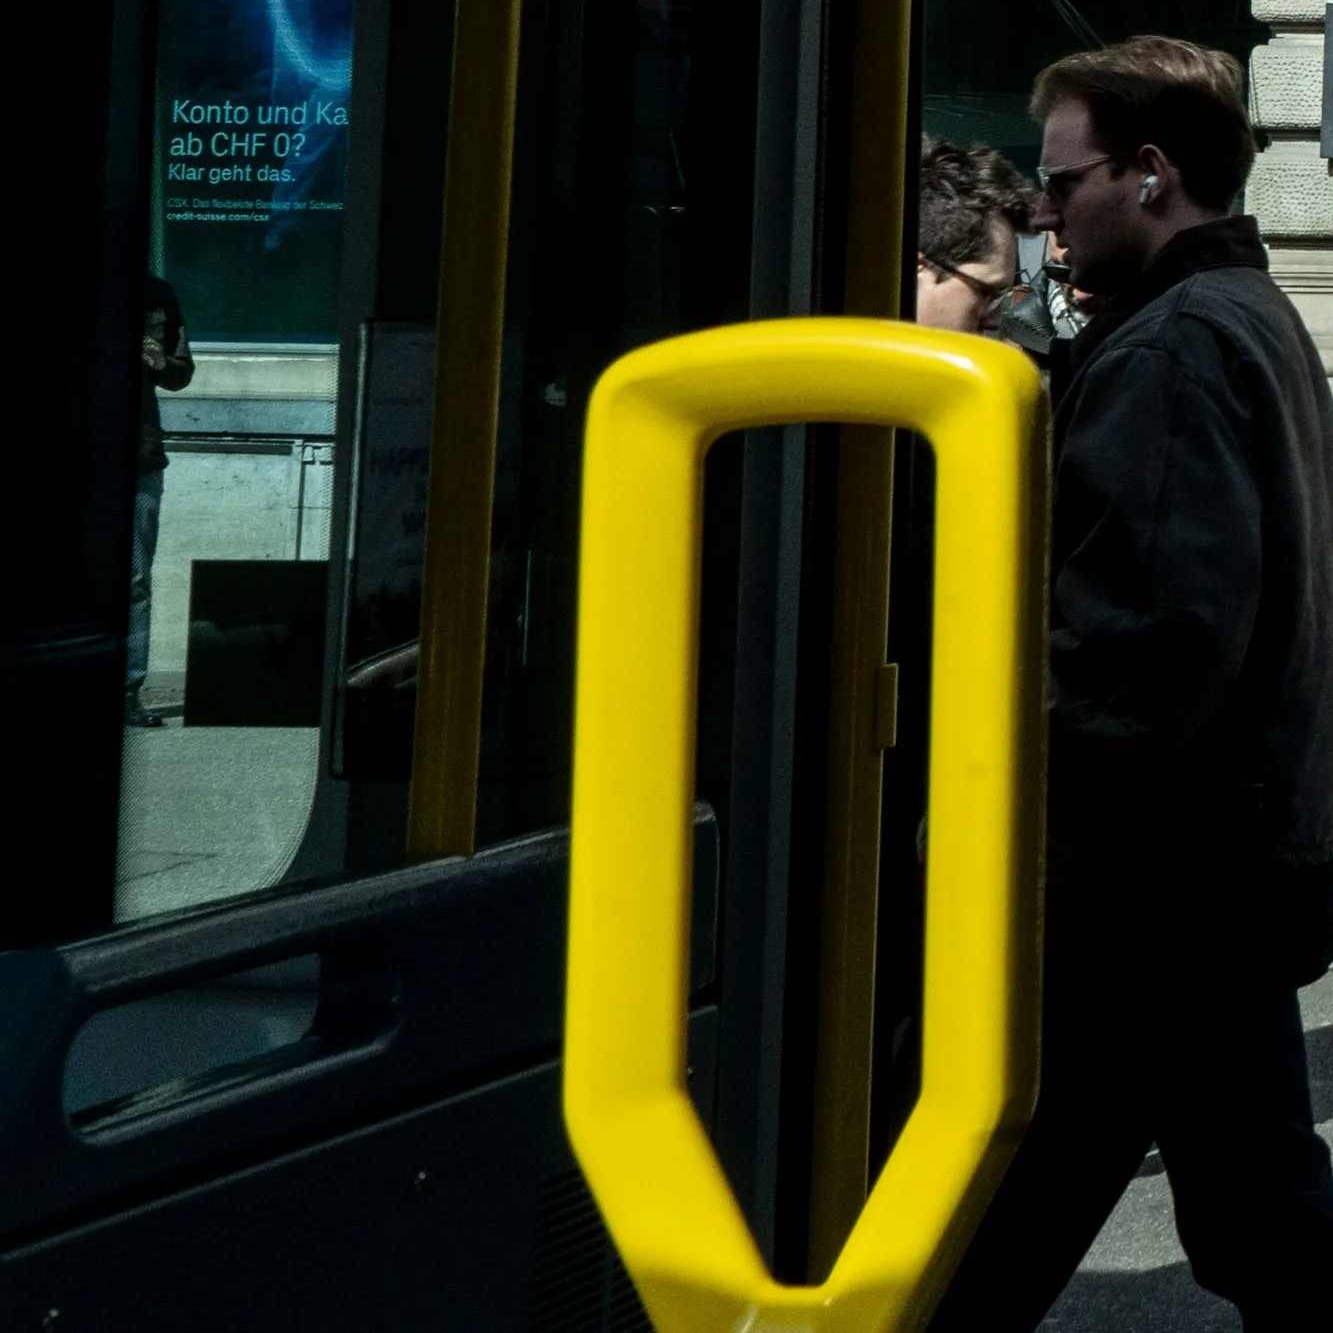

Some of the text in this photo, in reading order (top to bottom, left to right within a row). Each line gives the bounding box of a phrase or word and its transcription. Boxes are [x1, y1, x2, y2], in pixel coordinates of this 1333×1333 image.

[171, 99, 349, 126] Konto und Ka
[169, 132, 306, 158] ab CHF 0?
[167, 163, 297, 184] Klar geht das.
[165, 211, 270, 222] credit-suisse.com/csx
